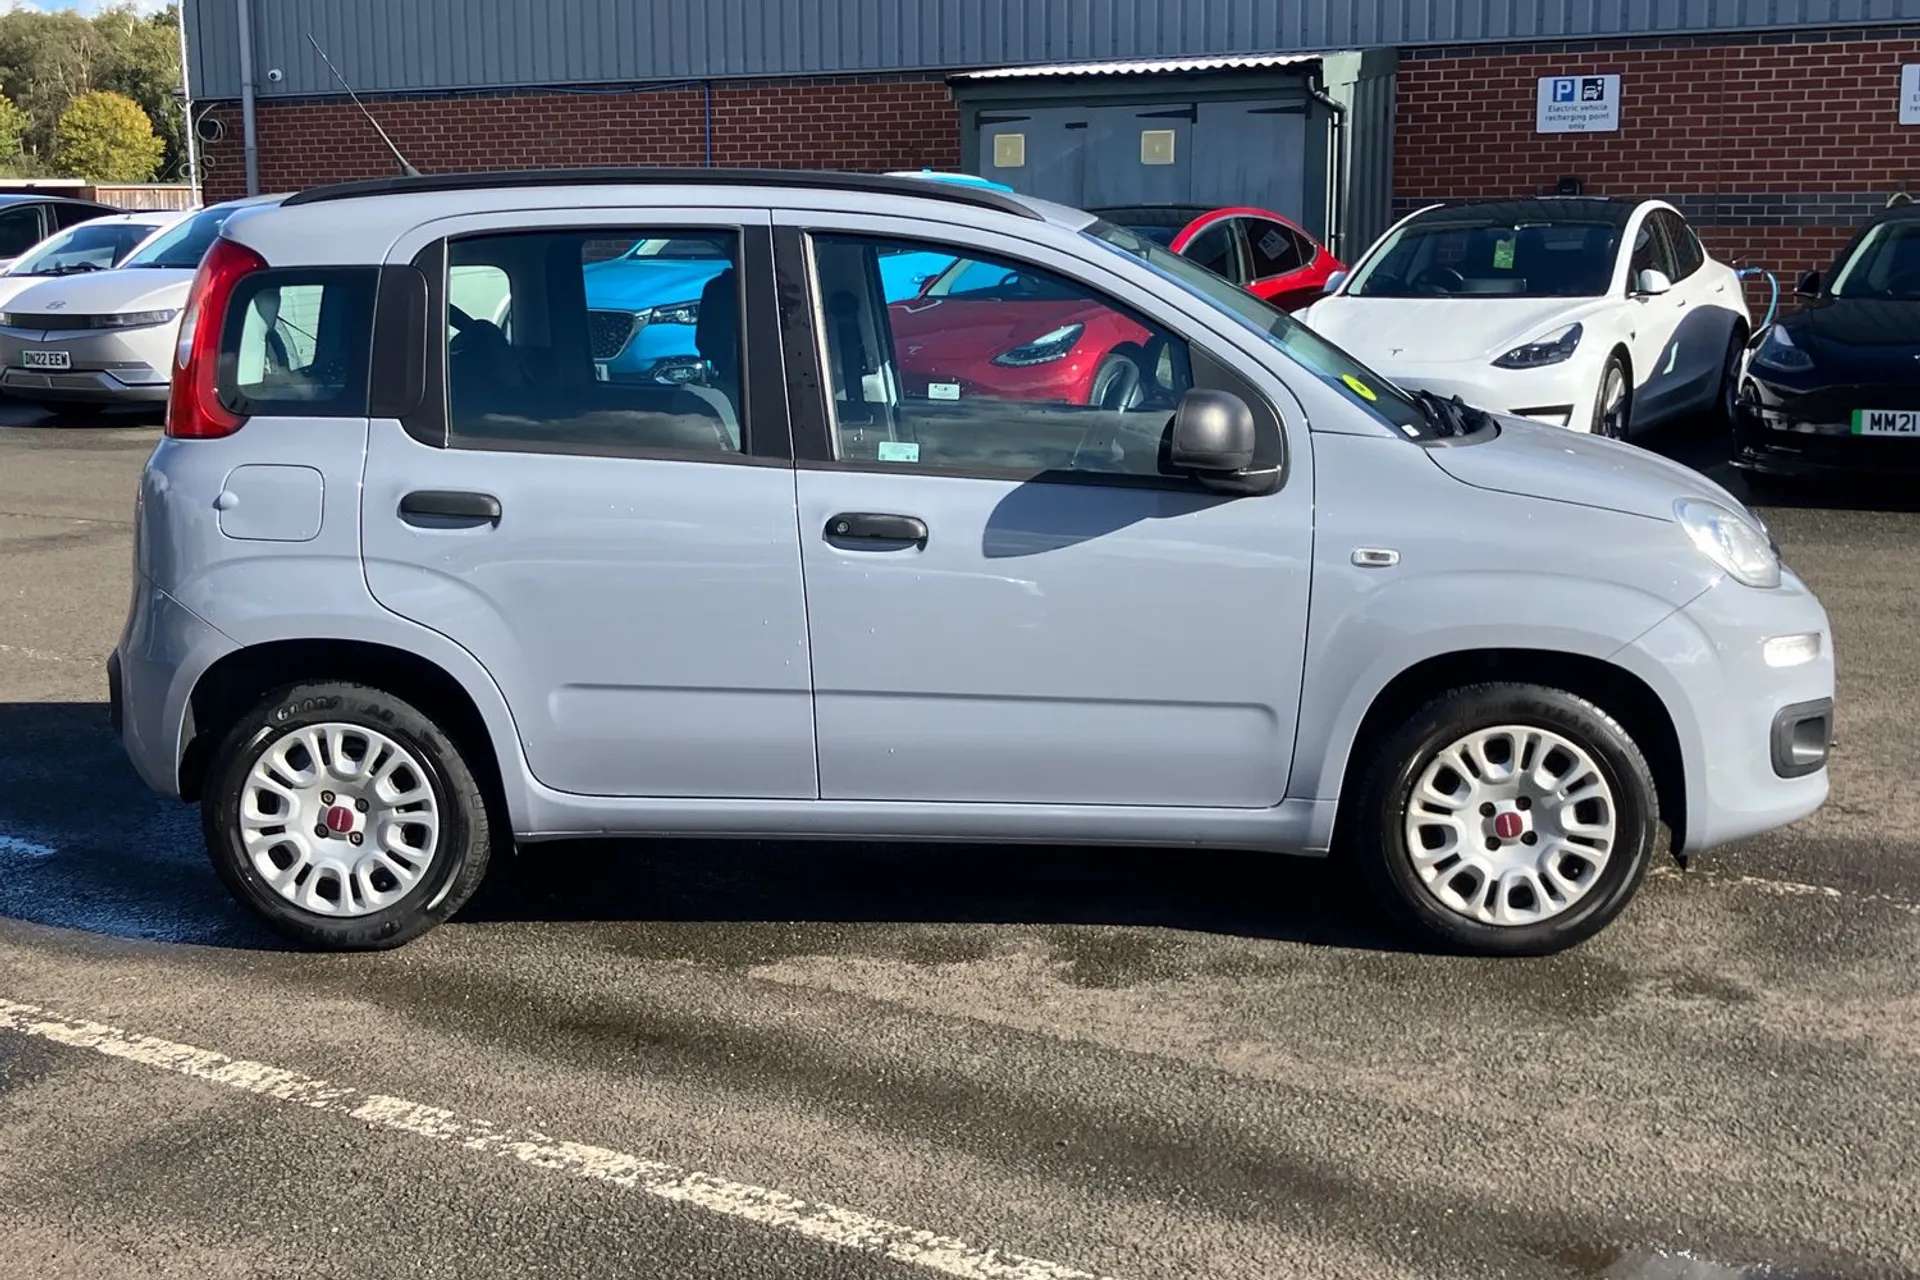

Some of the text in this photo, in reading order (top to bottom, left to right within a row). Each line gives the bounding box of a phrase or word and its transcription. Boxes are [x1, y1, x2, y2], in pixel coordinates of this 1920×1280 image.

[1556, 81, 1573, 101] P
[1548, 104, 1579, 112] Electric
[1545, 113, 1609, 122] recharging point
[1870, 413, 1916, 432] MM21
